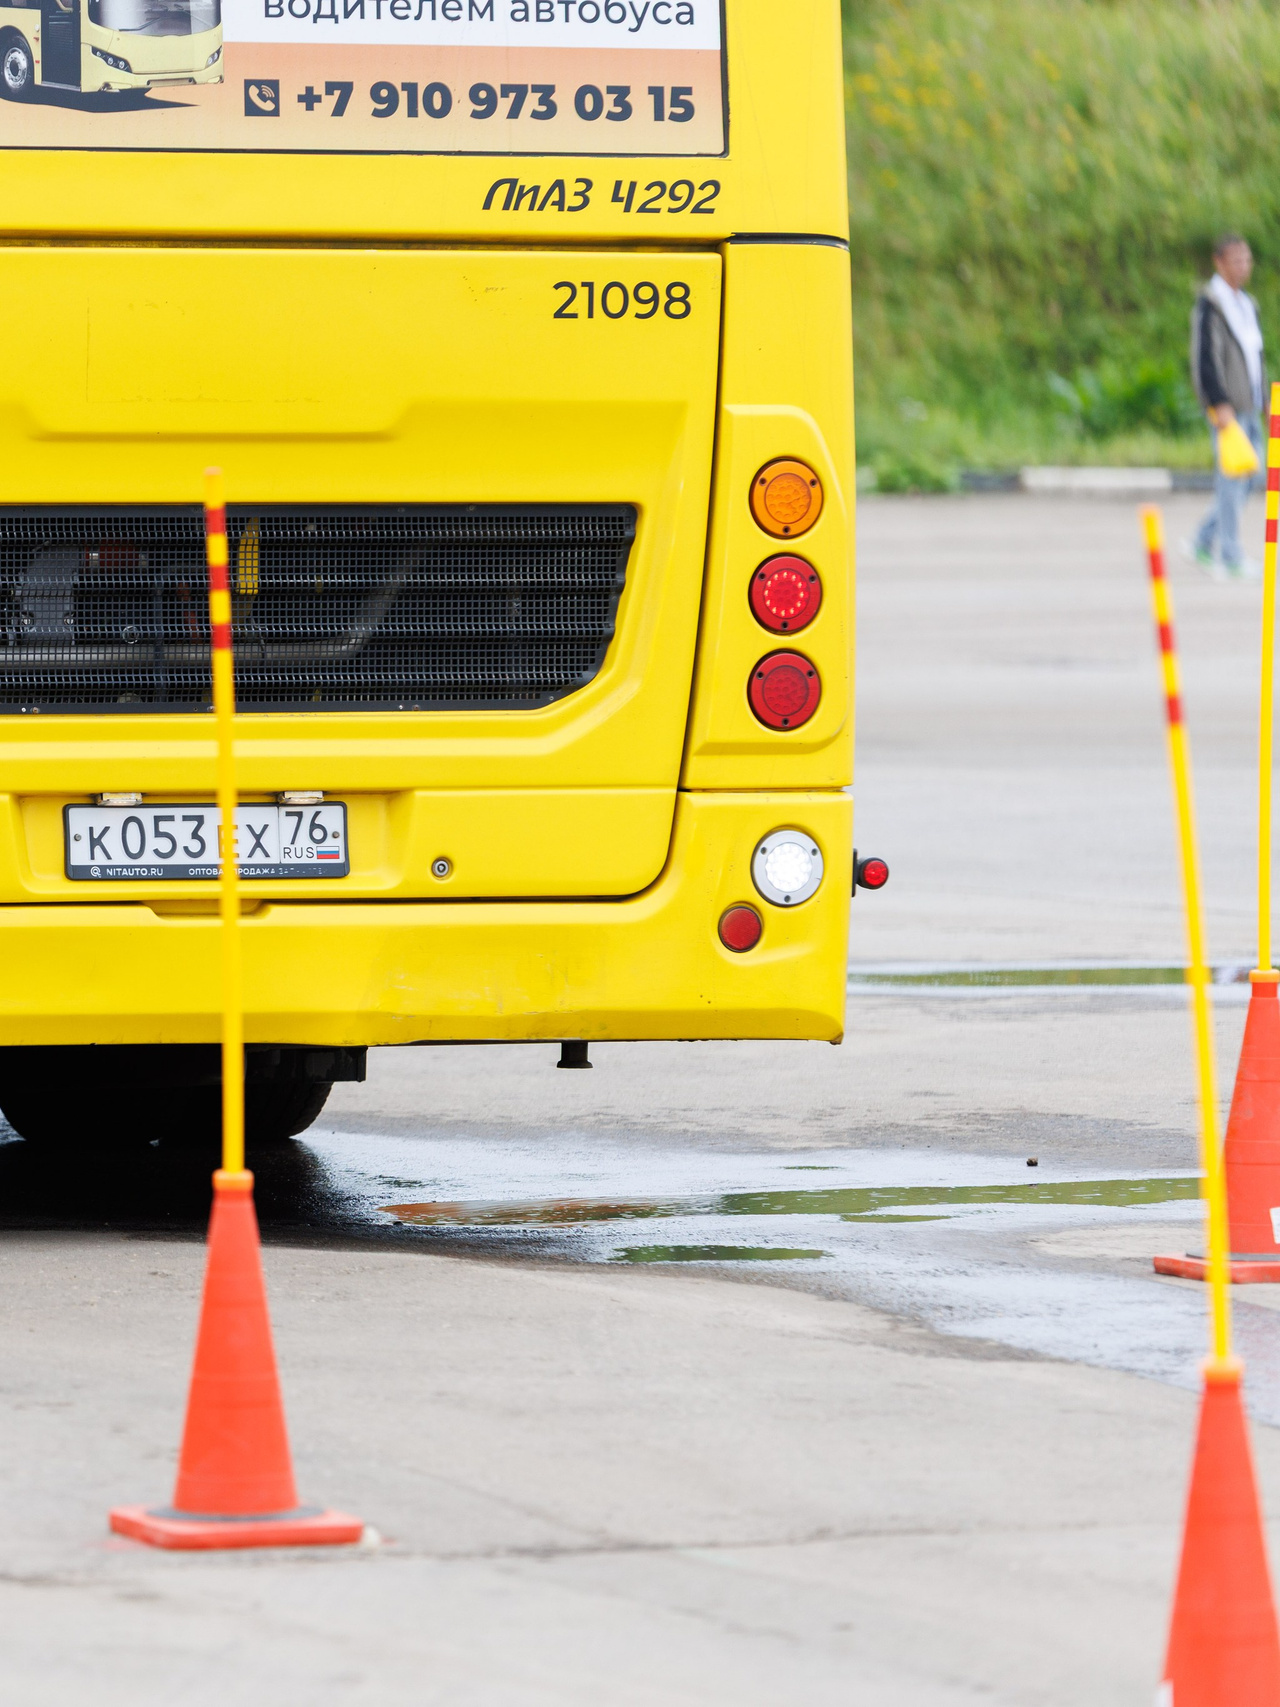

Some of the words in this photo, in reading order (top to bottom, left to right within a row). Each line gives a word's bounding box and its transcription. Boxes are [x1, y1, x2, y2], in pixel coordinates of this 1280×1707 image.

[264, 0, 495, 24] водителем
[509, 0, 695, 33] автобуса
[296, 81, 354, 118] +7
[369, 81, 453, 119] 910
[468, 82, 558, 121] 973
[574, 84, 633, 122] 03
[648, 86, 695, 123] 15
[482, 177, 594, 213] ЛиАЗ
[610, 179, 722, 215] 4292
[552, 280, 692, 320] 21098
[284, 810, 329, 845] 76
[283, 846, 315, 859] RUS
[106, 867, 164, 876] NITAUTO.RU
